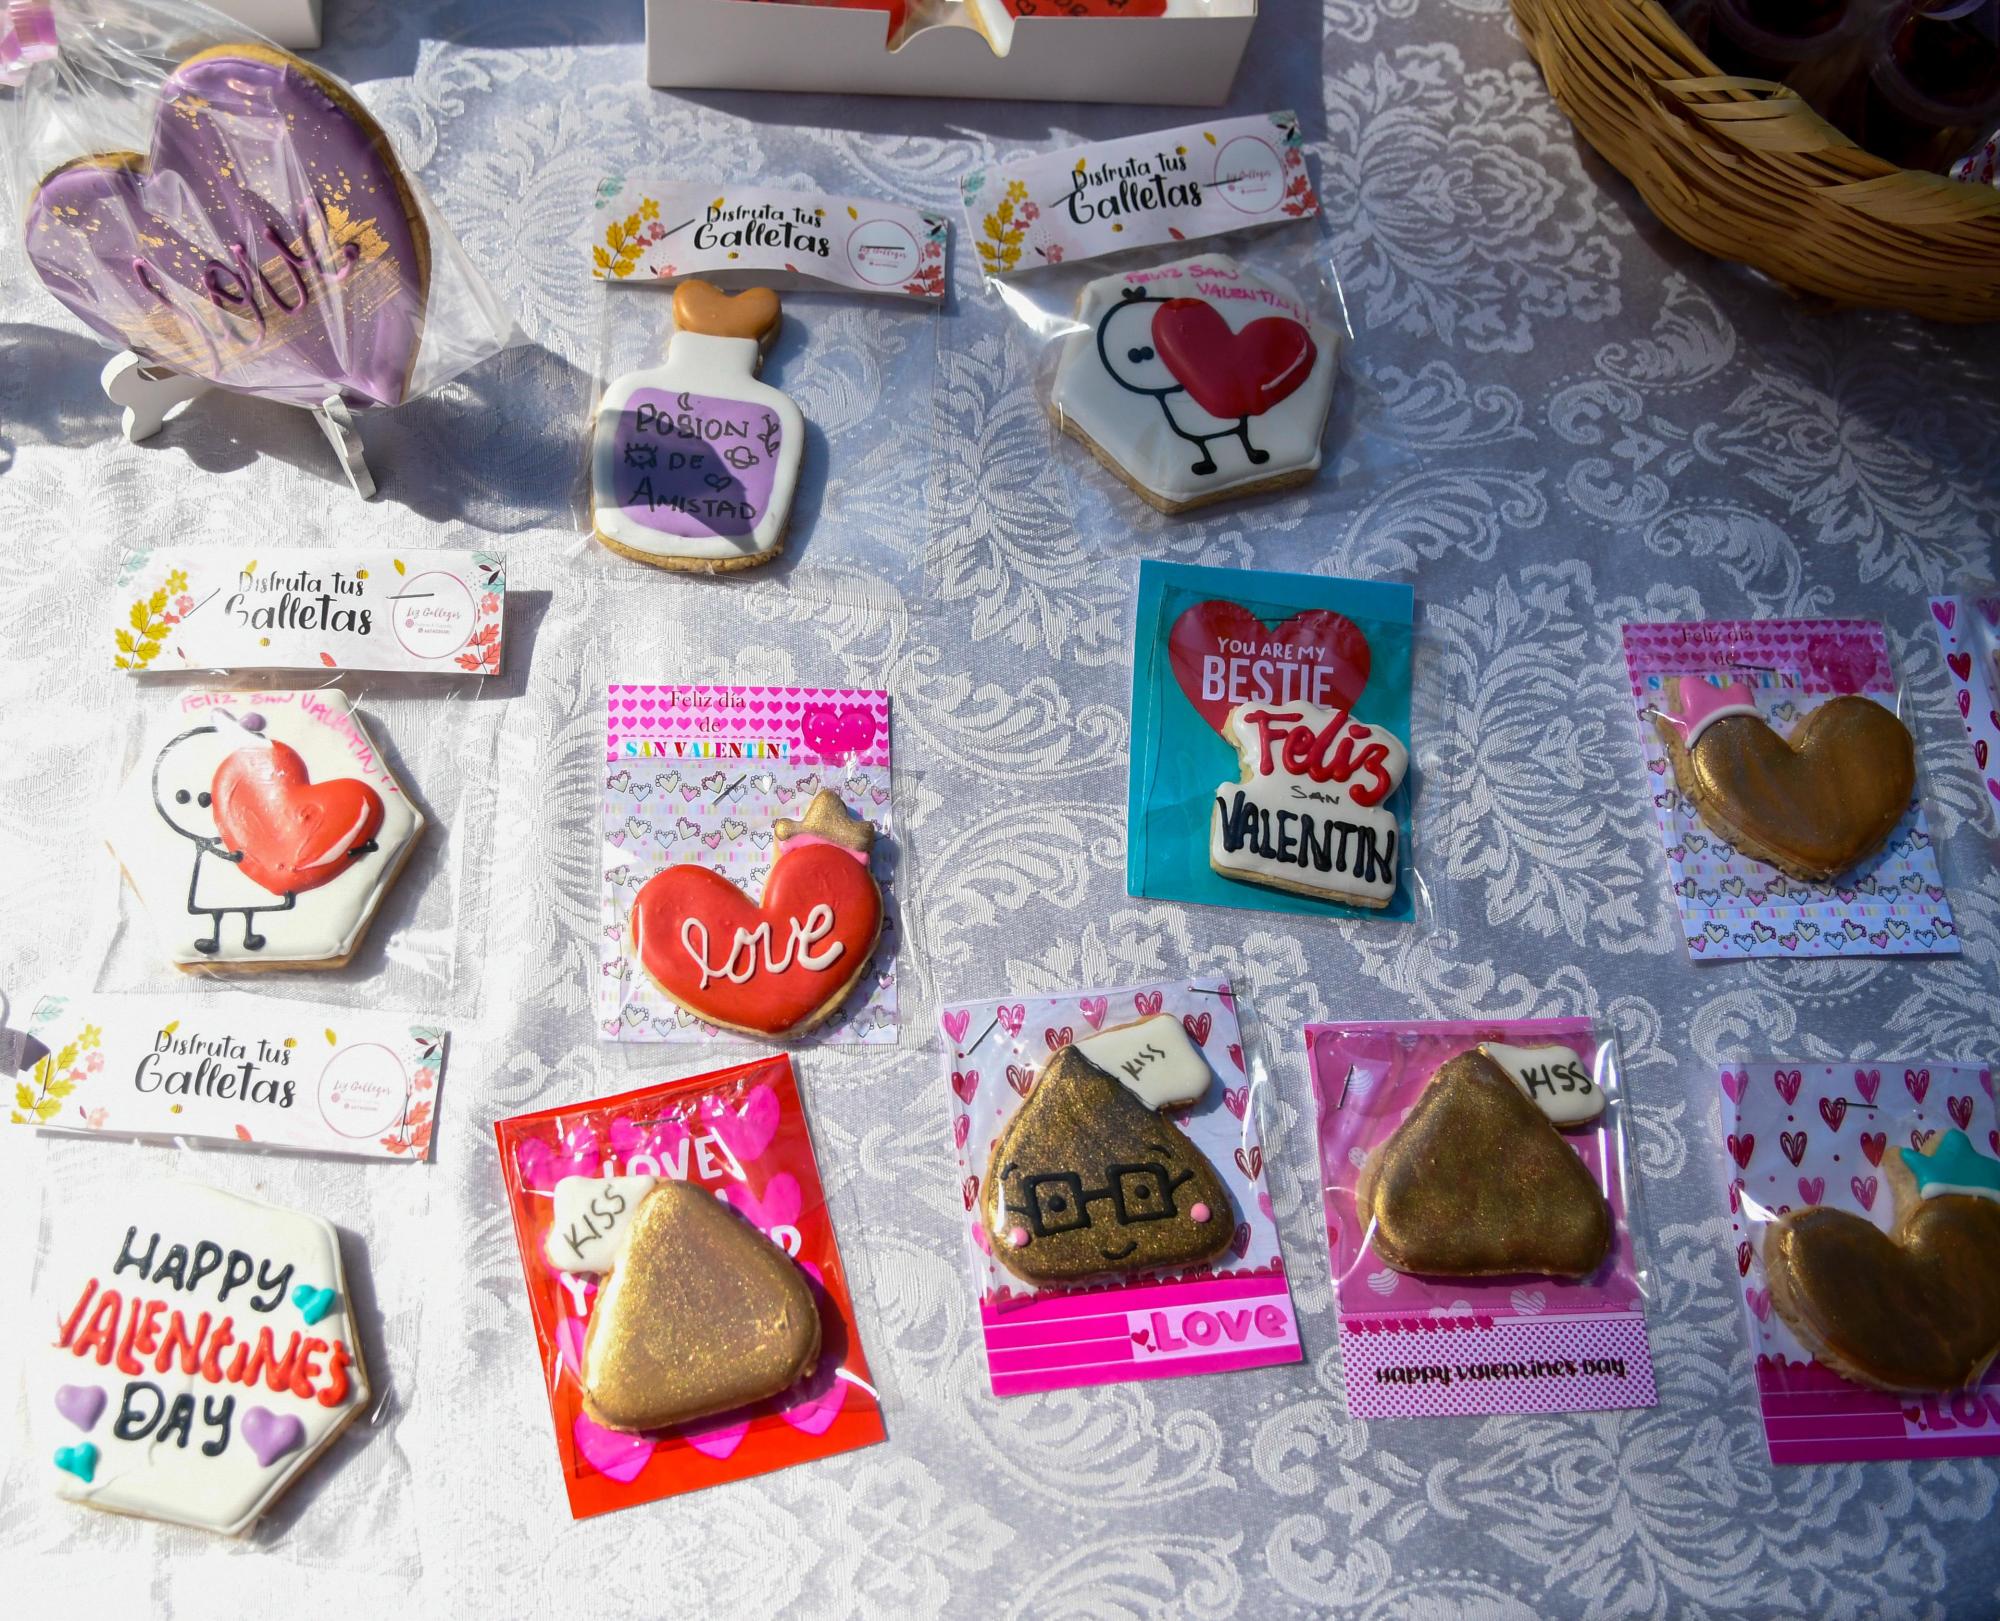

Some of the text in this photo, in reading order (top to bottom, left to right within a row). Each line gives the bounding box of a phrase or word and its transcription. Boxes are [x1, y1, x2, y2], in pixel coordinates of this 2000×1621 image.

[1072, 152, 1187, 190] Disfruta tus
[706, 203, 823, 229] Disfruta tus
[1067, 174, 1202, 224] Galletas
[693, 218, 831, 258] Galletas
[668, 451, 705, 471] DE
[627, 475, 757, 520] AMISTAD
[239, 569, 365, 597] Disfruta tus
[224, 592, 373, 636] Galletas
[1217, 636, 1326, 662] YOU ARE MY
[671, 690, 746, 708] Feliz día
[1202, 654, 1334, 710] BESTIE
[699, 716, 721, 733] de
[624, 740, 667, 759] SAN
[1290, 784, 1341, 806] SAN
[1215, 789, 1396, 884] VALENTIN
[680, 902, 845, 990] love
[154, 1029, 291, 1067] Disfruta tus
[1120, 1043, 1167, 1082] KISS
[135, 1053, 297, 1109] Galletas
[1520, 1060, 1594, 1099] KISS
[562, 1184, 627, 1260] KISS
[112, 1224, 296, 1313] HAPPY
[1376, 1363, 1451, 1387] Happy
[1582, 1356, 1627, 1380] Day
[112, 1380, 237, 1457] DAY
